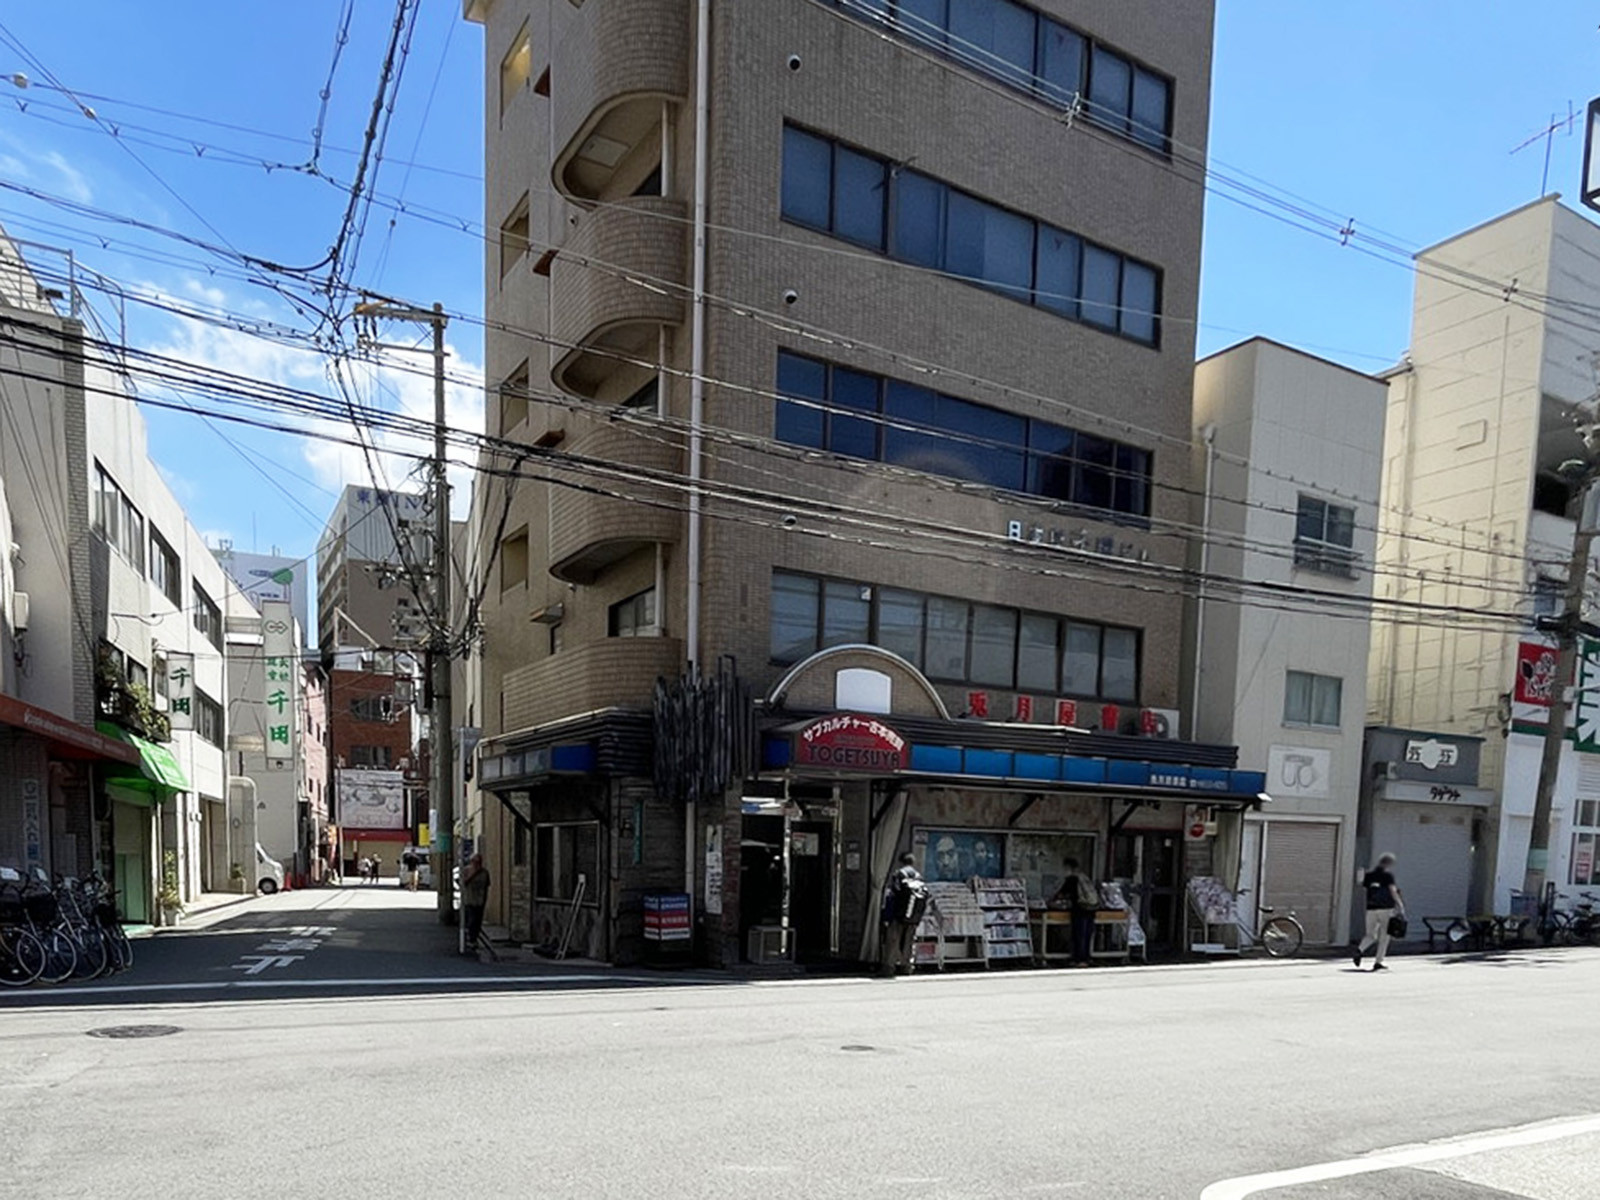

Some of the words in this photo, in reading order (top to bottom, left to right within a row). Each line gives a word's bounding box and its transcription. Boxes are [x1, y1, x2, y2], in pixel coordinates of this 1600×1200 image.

[169, 667, 191, 716] 千田
[266, 689, 290, 745] 千田
[807, 743, 902, 768] TOGETSUYA
